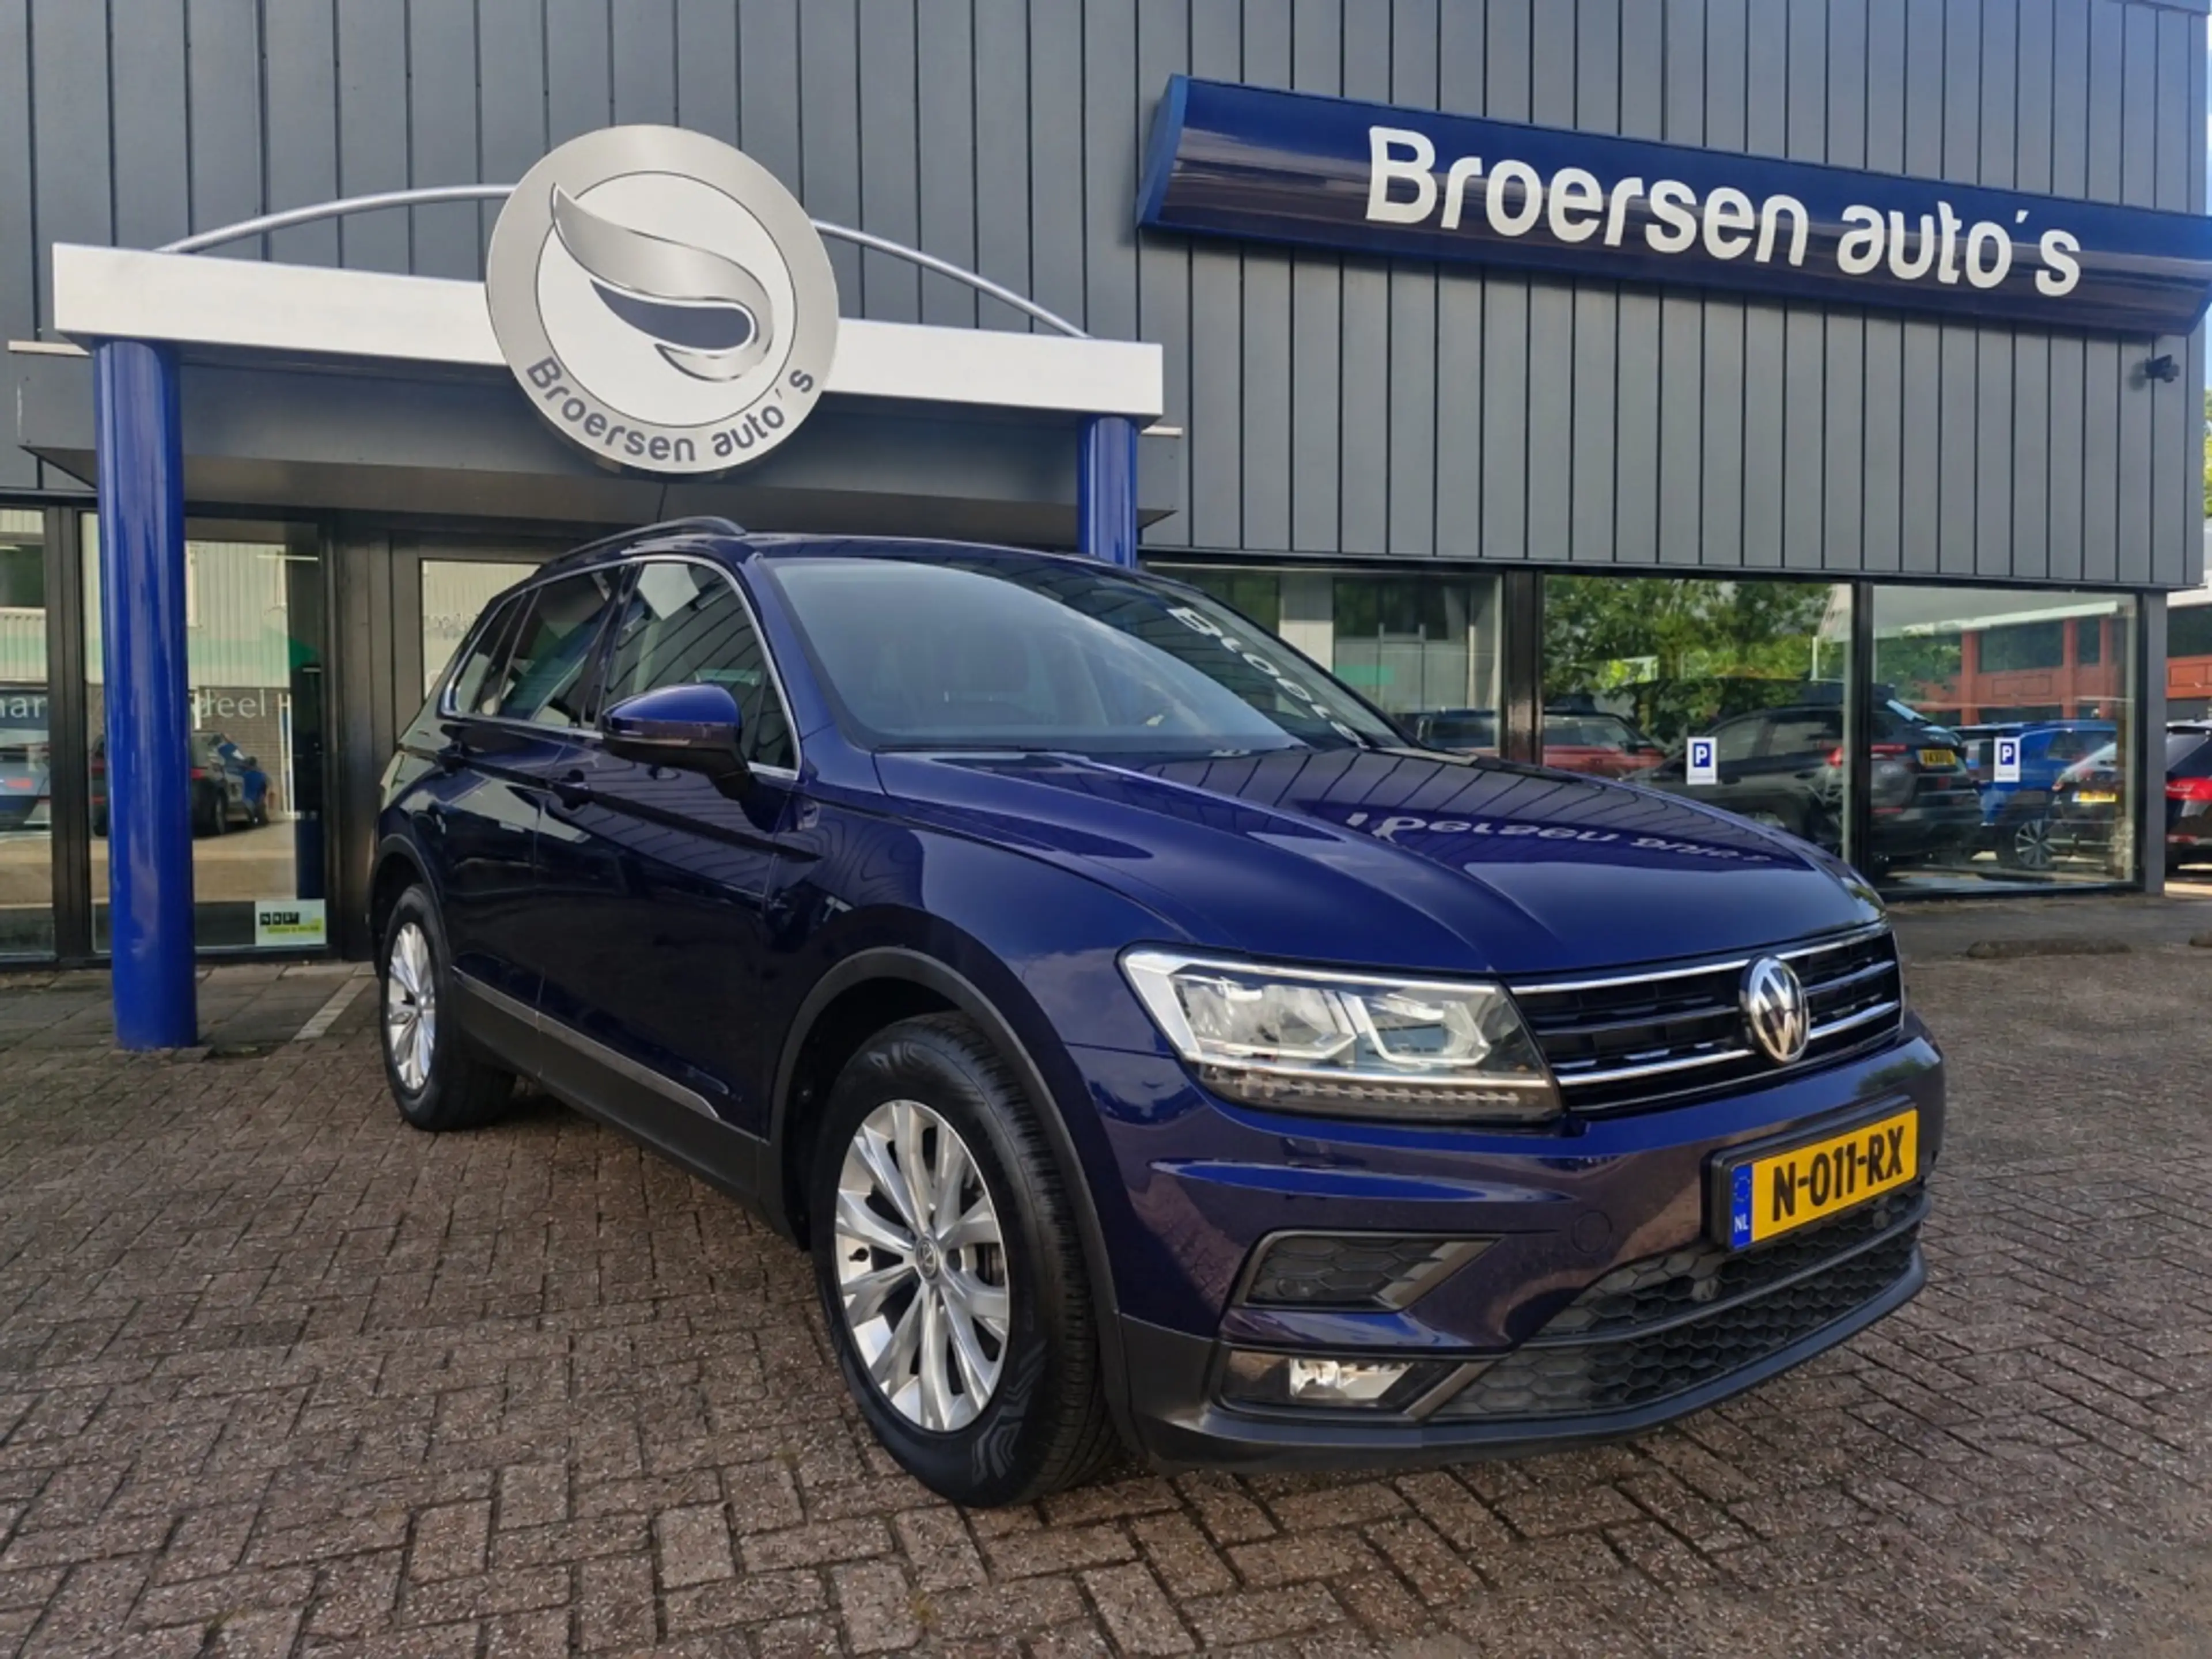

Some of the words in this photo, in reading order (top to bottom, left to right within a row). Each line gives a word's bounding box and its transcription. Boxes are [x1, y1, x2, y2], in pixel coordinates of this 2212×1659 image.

[1366, 126, 1808, 266] Broersen
[526, 357, 696, 462] Broersen
[1695, 745, 1707, 765] P
[2002, 745, 2012, 762] P
[1772, 1125, 1904, 1221] N-011-RX
[1734, 1216, 1749, 1232] NL
